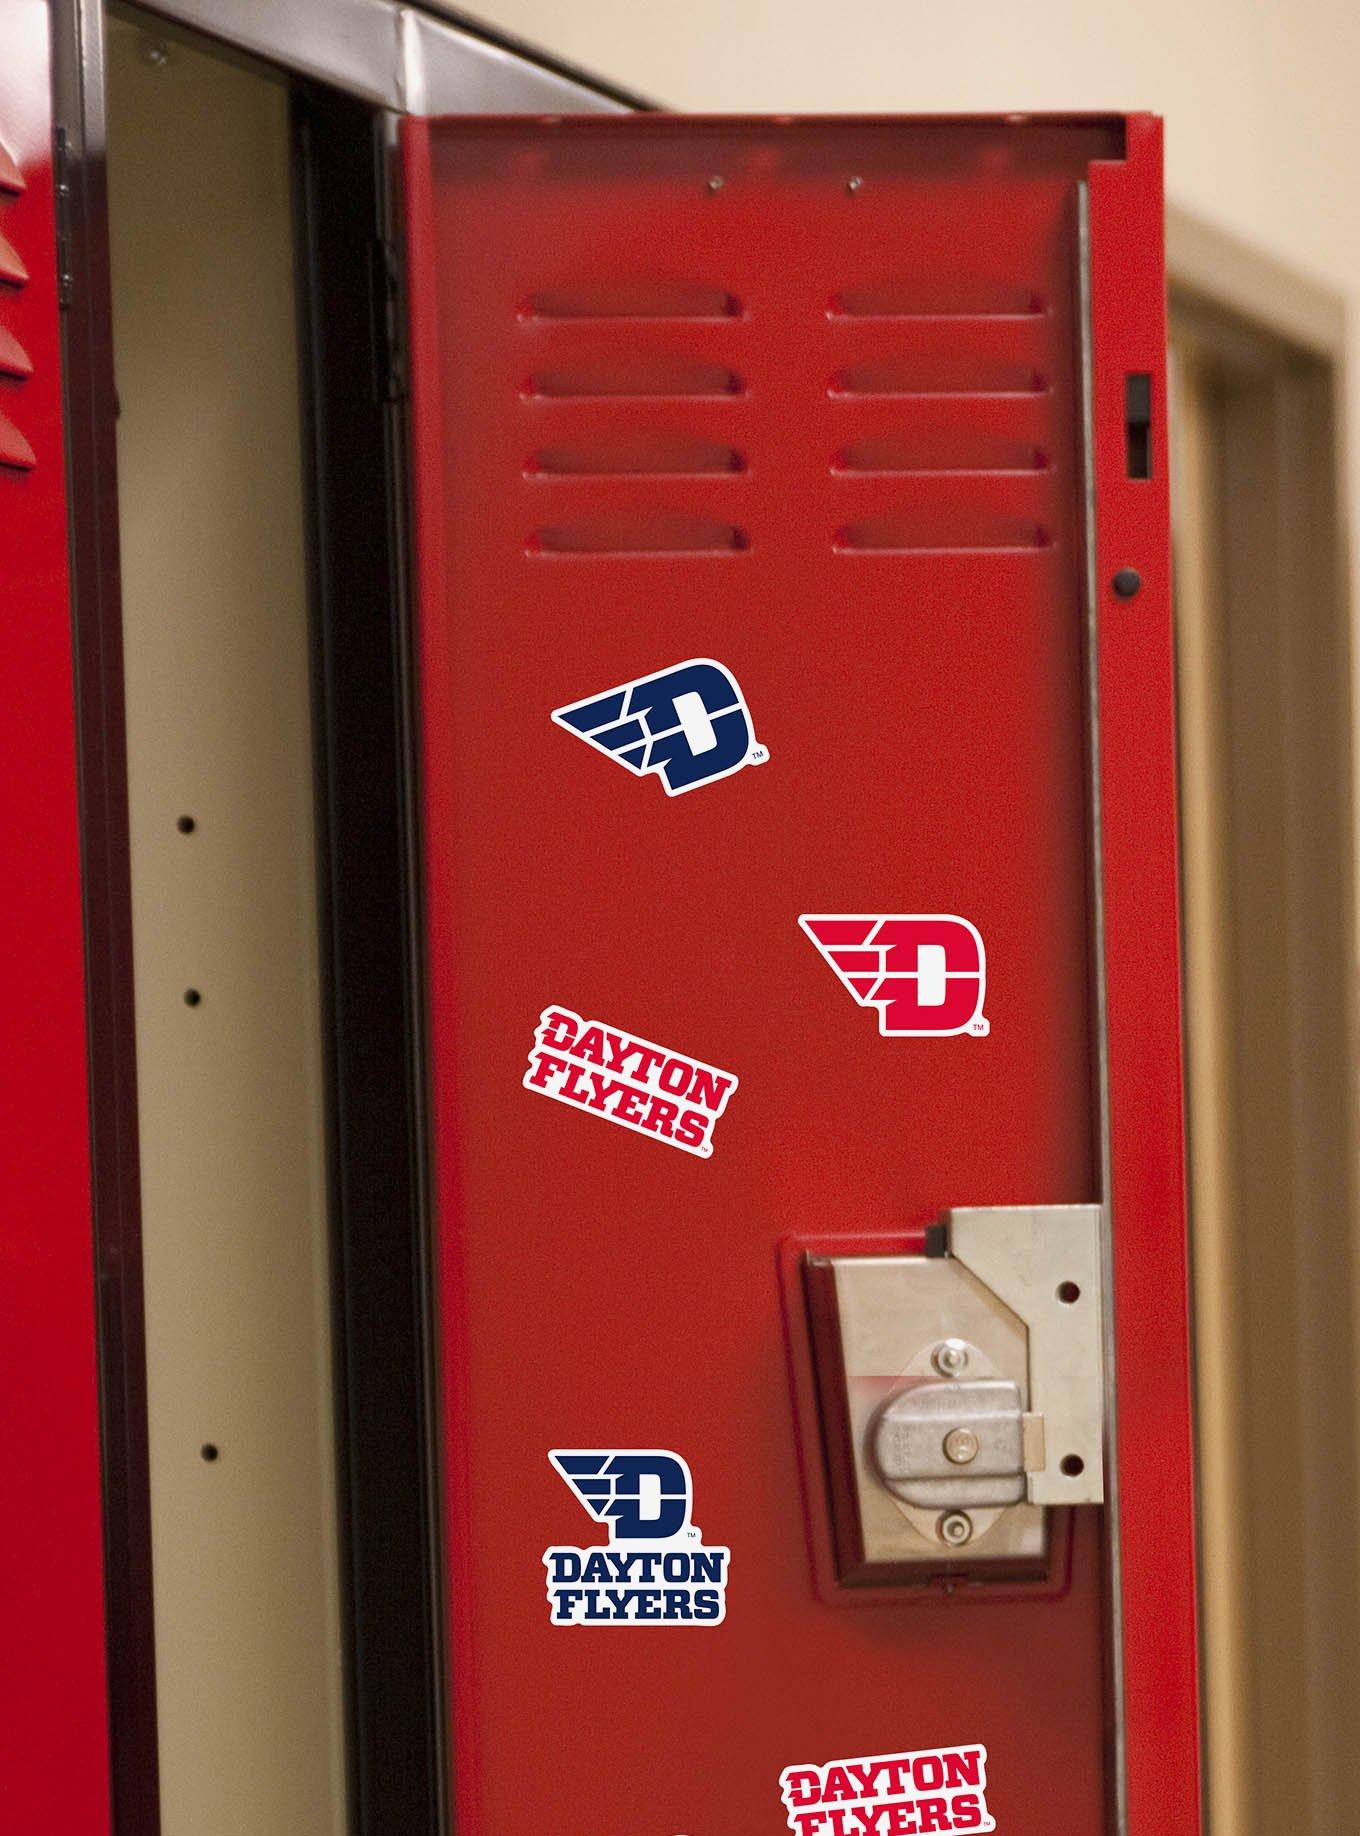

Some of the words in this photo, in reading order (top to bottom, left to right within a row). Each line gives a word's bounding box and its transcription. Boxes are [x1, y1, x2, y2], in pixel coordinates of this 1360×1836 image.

[626, 664, 750, 791] D
[752, 751, 764, 760] TM
[869, 920, 980, 1031] D
[529, 1051, 709, 1148] FLYERS
[541, 1011, 732, 1112] DAYTON
[603, 1455, 687, 1539] D
[549, 1552, 724, 1583] DAYTON
[553, 1589, 720, 1620] FLYERS
[785, 1750, 980, 1807] DAYTON
[793, 1793, 982, 1836] FLYERS
